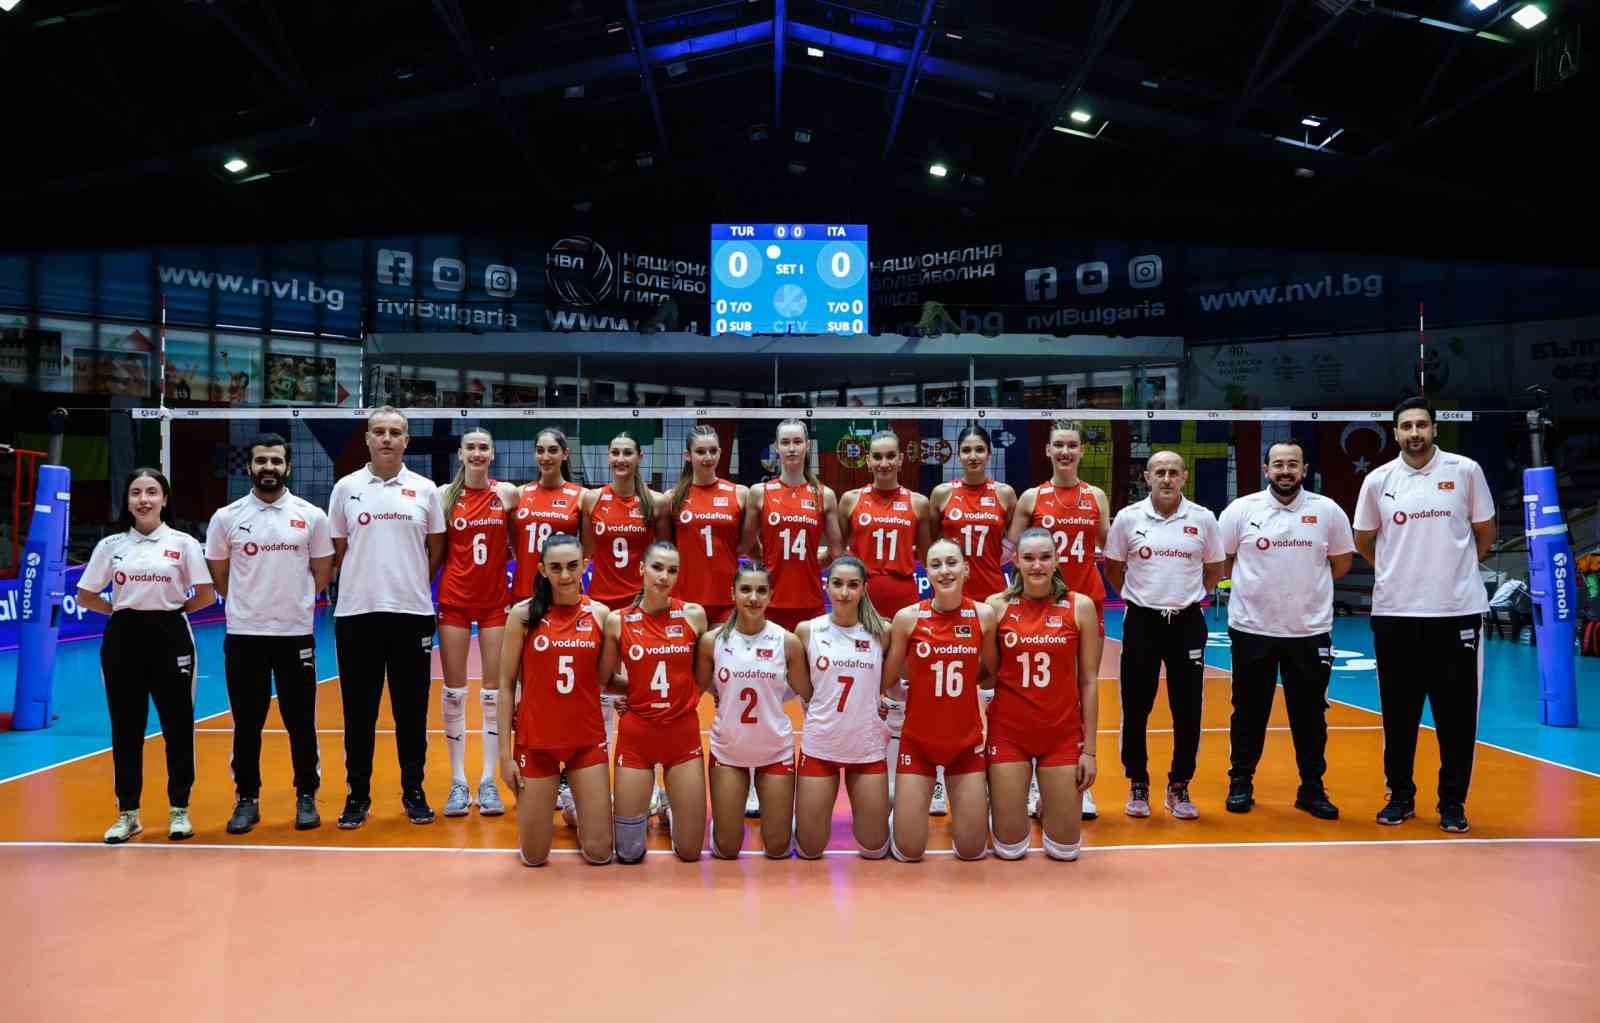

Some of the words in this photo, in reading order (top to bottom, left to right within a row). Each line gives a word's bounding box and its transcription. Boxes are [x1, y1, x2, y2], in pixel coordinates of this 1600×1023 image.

[730, 226, 755, 237] TUR
[777, 226, 785, 237] 0
[794, 226, 802, 237] 0
[827, 226, 846, 237] ITA
[546, 250, 585, 270] НВЛ
[729, 251, 748, 277] 0
[776, 264, 797, 274] SET
[831, 251, 850, 277] 0
[159, 266, 344, 311] www.nvl.bg
[1200, 273, 1384, 312] www.nvl.bg
[716, 300, 727, 314] 0
[730, 302, 752, 312] T/O
[827, 302, 849, 312] T/O
[852, 300, 863, 314] 0
[1026, 299, 1166, 329] nvlBulgaria
[716, 319, 727, 333] 0
[730, 321, 752, 331] SUB
[827, 321, 849, 331] SUB
[852, 319, 863, 333] 0
[373, 512, 412, 521] vodafone
[872, 515, 912, 526] vodafone
[1408, 509, 1451, 519] vodafone
[261, 543, 299, 552] vodafone
[473, 533, 488, 565] 6
[701, 525, 714, 557] 1
[779, 528, 807, 560] 14
[872, 528, 898, 560] 11
[961, 524, 989, 557] 17
[1053, 531, 1085, 563] 24
[1272, 538, 1312, 547] vodafone
[613, 537, 629, 568] 9
[1153, 548, 1192, 559] vodafone
[129, 573, 172, 583] vodafone
[22, 571, 36, 620] Senoh
[1555, 568, 1570, 619] Senoh
[552, 639, 595, 648] vodafone
[1020, 635, 1066, 645] vodafone
[832, 659, 875, 669] vodafone
[1017, 652, 1050, 688] 13
[556, 655, 575, 694] 5
[650, 661, 670, 698] 4
[732, 669, 776, 680] vodafone
[931, 660, 964, 697] 16
[837, 676, 854, 713] 7
[739, 687, 758, 724] 2
[519, 754, 526, 767] 5
